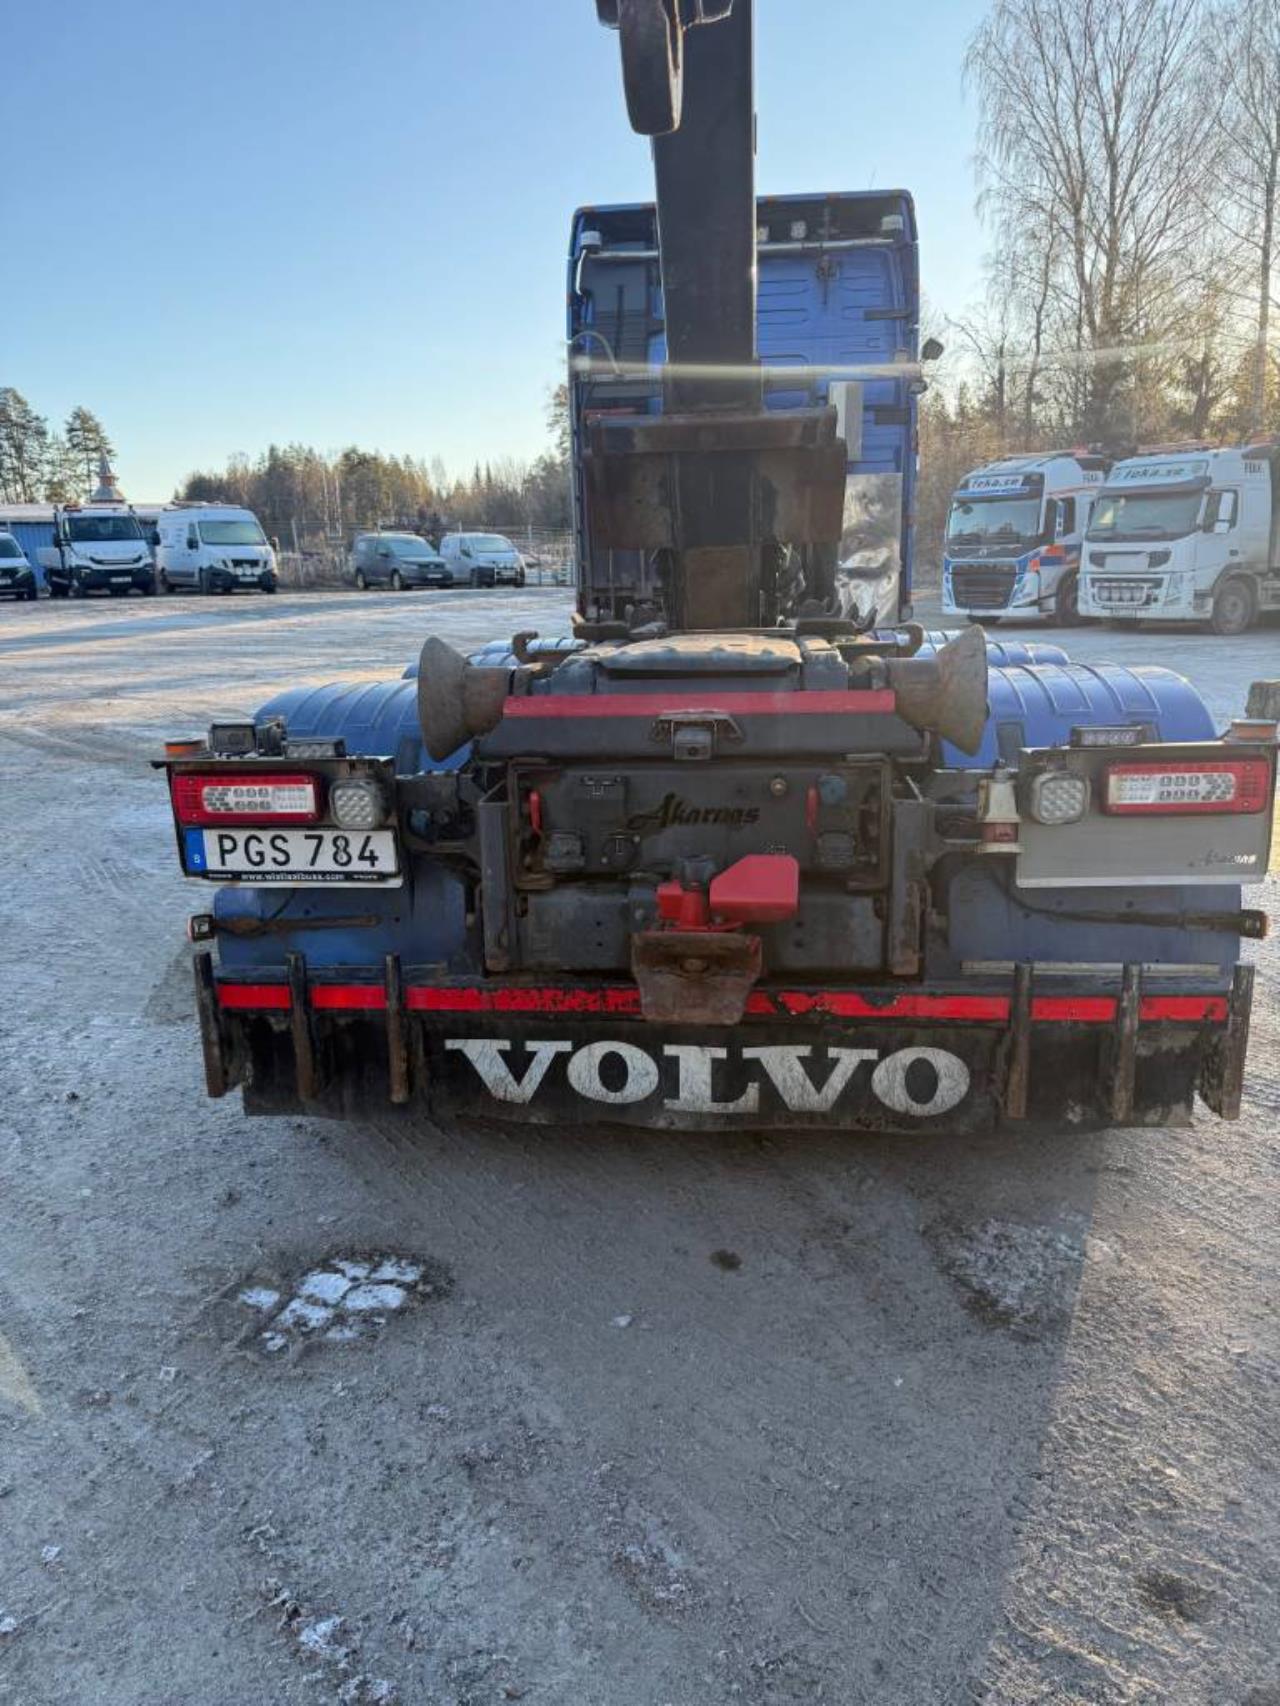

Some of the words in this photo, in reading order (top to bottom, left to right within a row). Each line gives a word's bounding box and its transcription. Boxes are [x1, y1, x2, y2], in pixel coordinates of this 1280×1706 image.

[217, 833, 291, 867] PGS
[303, 833, 380, 868] 784
[444, 1037, 971, 1117] VOLVO
